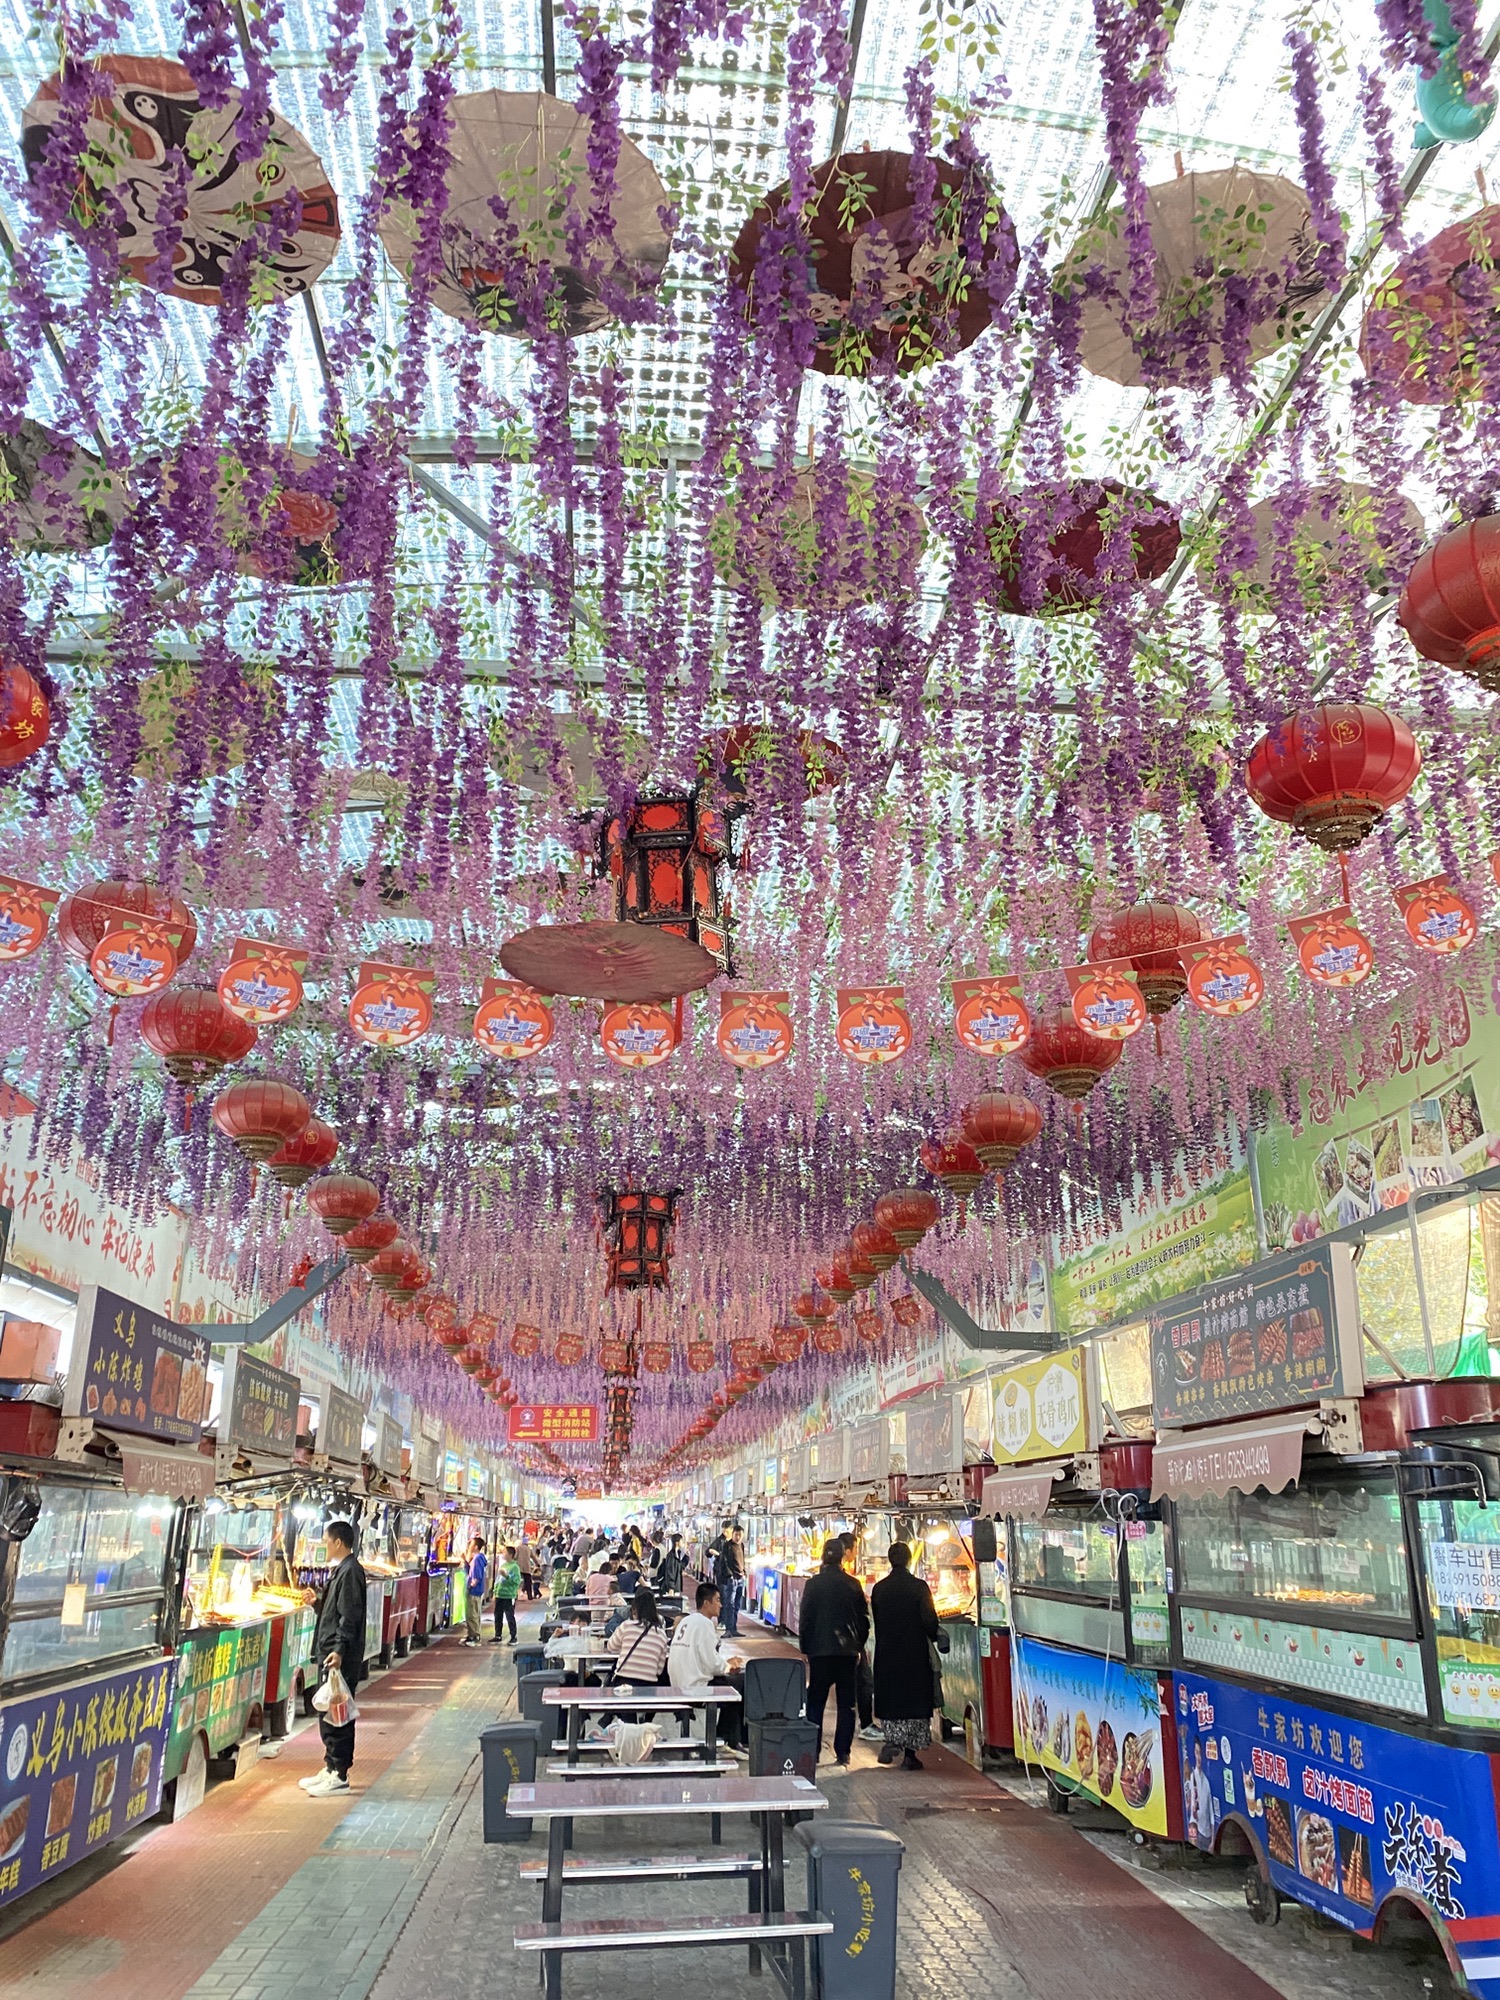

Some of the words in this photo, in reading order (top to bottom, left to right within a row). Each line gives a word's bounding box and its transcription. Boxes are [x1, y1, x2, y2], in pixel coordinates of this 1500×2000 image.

[113, 1310, 137, 1348] 义乌
[542, 1418, 591, 1428] 微型消防站
[543, 1408, 591, 1418] 安全通道
[541, 1428, 591, 1438] 地下消防栓
[1258, 1706, 1365, 1770] 牛家坊欢迎您
[1252, 1747, 1290, 1789] 香飘飘
[1302, 1766, 1375, 1825] 卤汁烤面筋
[1382, 1801, 1466, 1920] 关东煮
